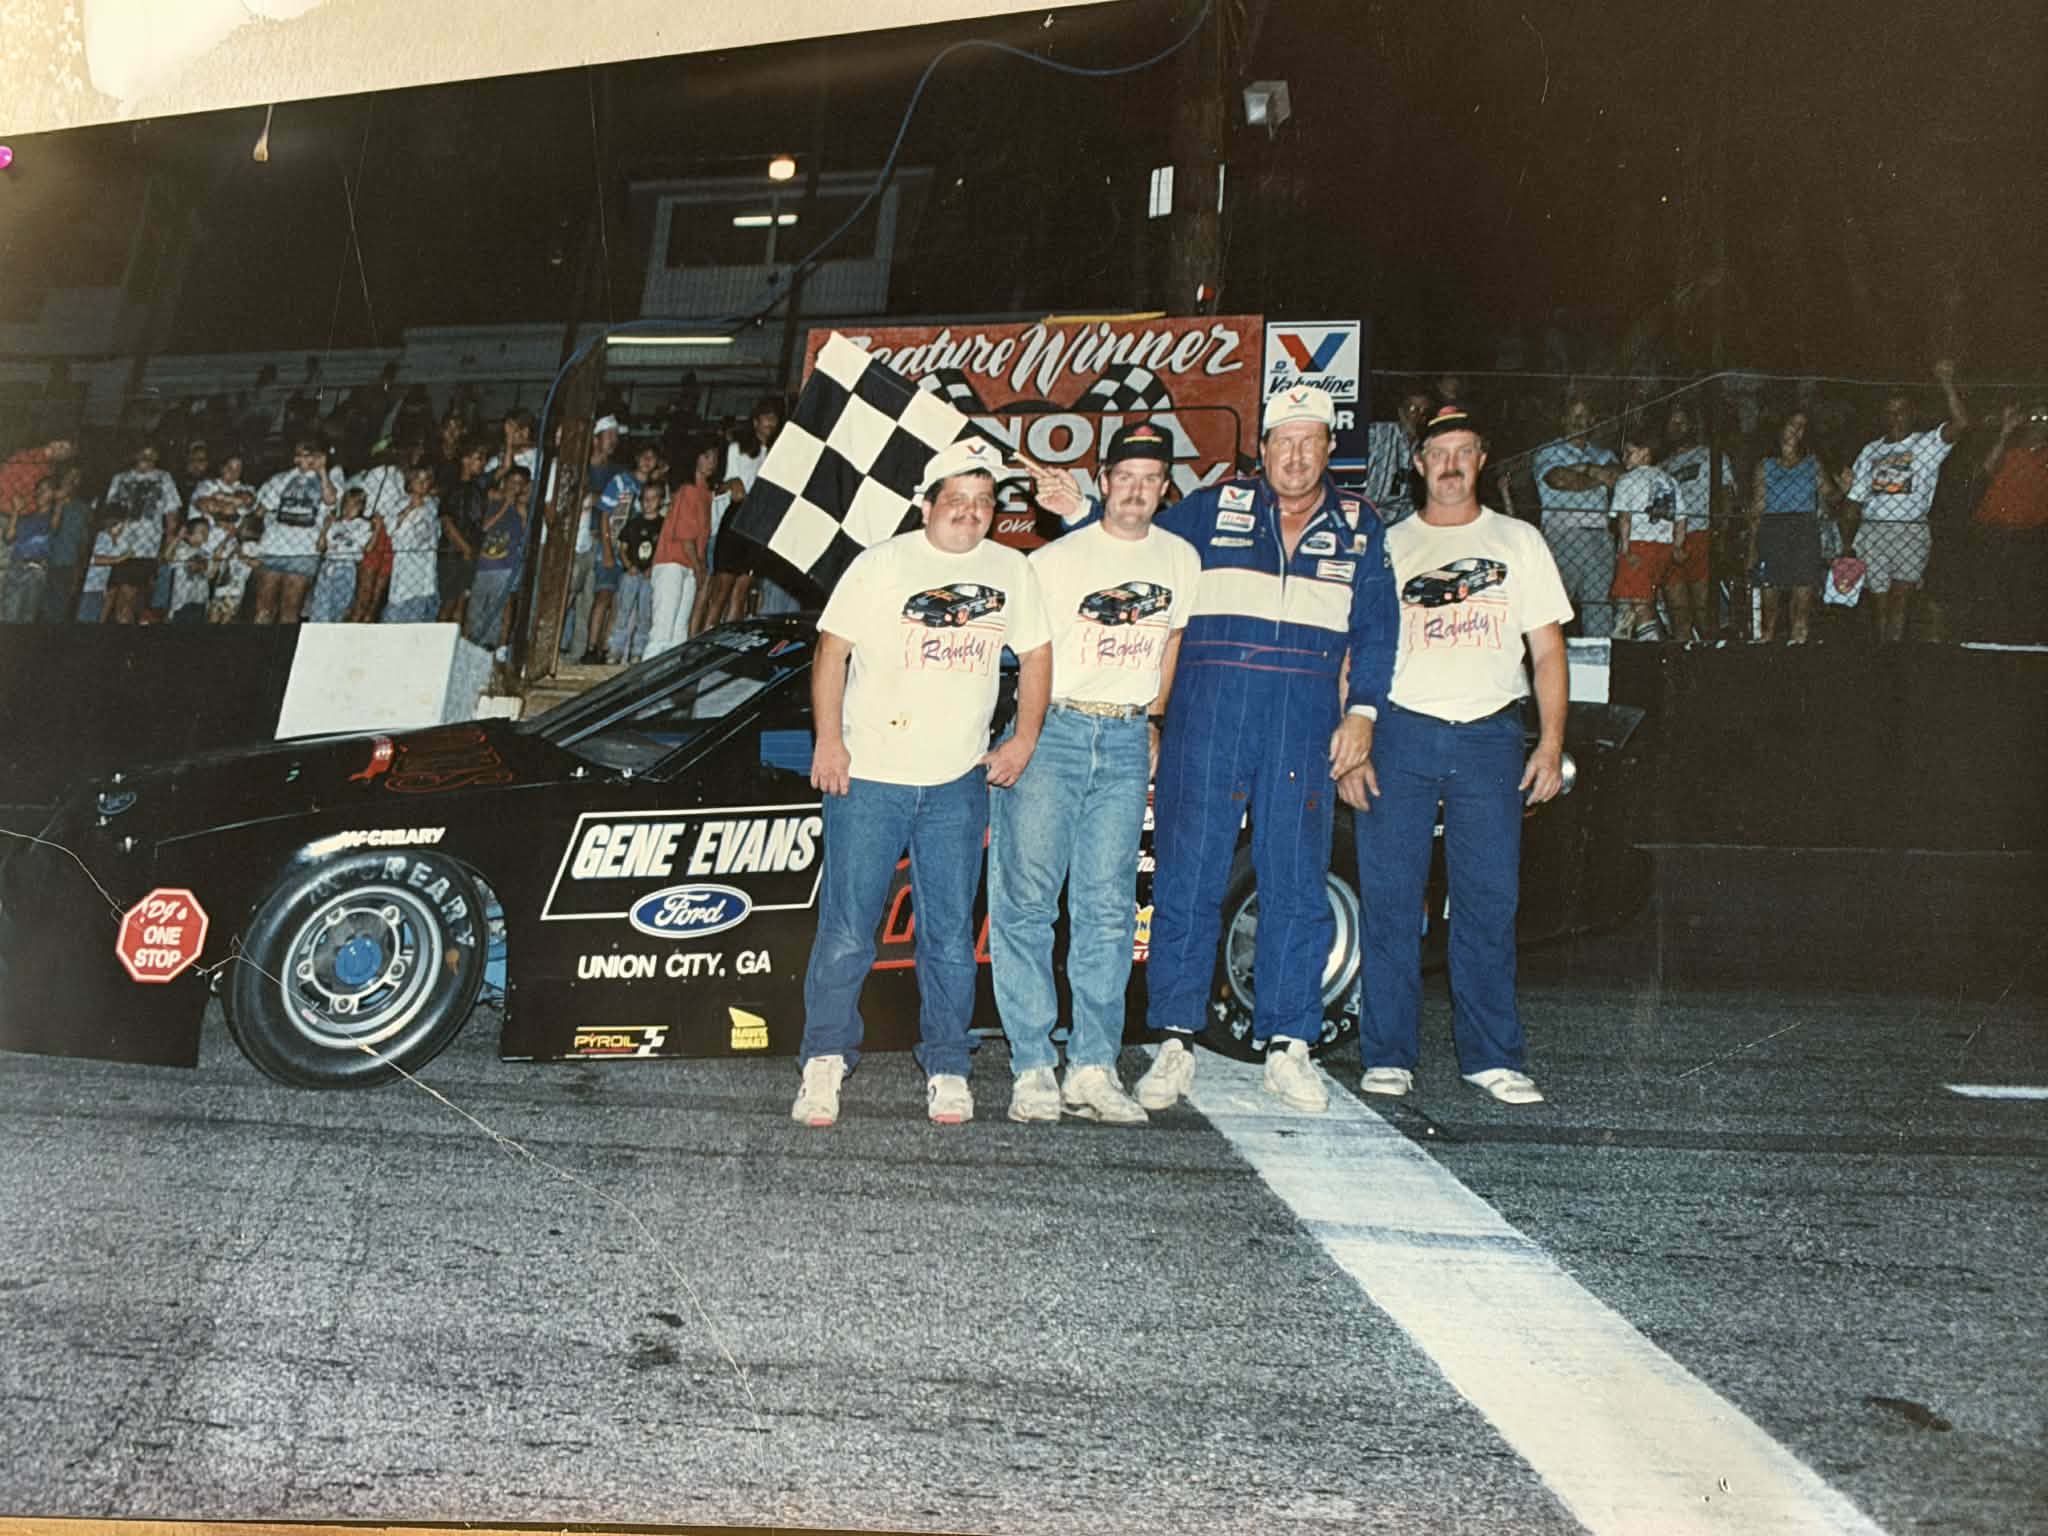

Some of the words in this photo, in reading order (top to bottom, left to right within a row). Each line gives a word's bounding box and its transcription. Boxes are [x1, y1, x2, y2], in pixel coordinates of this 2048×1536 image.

[1009, 323, 1242, 396] Winner
[1429, 611, 1491, 640] Randy
[921, 636, 986, 663] Randy
[1097, 635, 1155, 659] Randy
[571, 823, 686, 880] GENE
[687, 816, 824, 877] EVANS
[655, 891, 725, 927] Ford
[143, 925, 183, 945] ONE
[134, 948, 182, 968] STOP
[577, 954, 657, 979] UNION
[735, 950, 771, 975] GA
[574, 1033, 640, 1048] PYROIL
